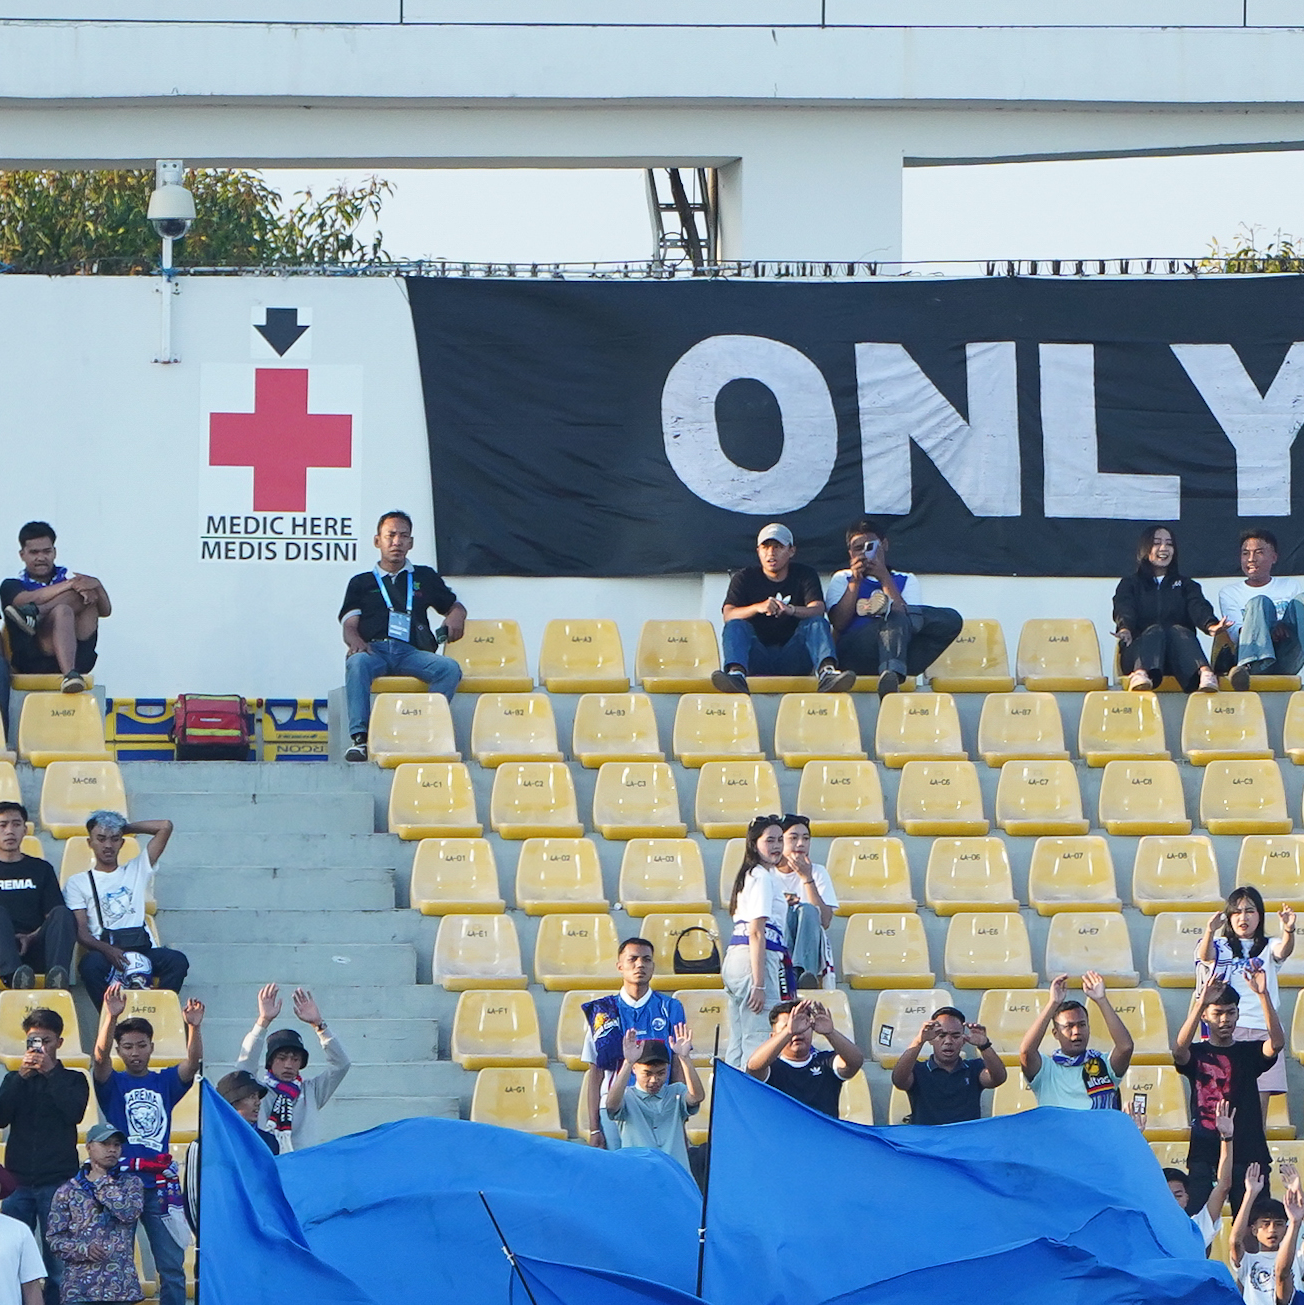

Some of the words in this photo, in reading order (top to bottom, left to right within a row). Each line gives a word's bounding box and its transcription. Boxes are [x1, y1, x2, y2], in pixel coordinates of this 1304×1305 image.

[206, 515, 284, 535] MEDIC
[291, 516, 353, 536] HERE
[201, 541, 277, 560] MEDIS
[285, 543, 357, 561] DISINI
[126, 1089, 158, 1105] AREMA
